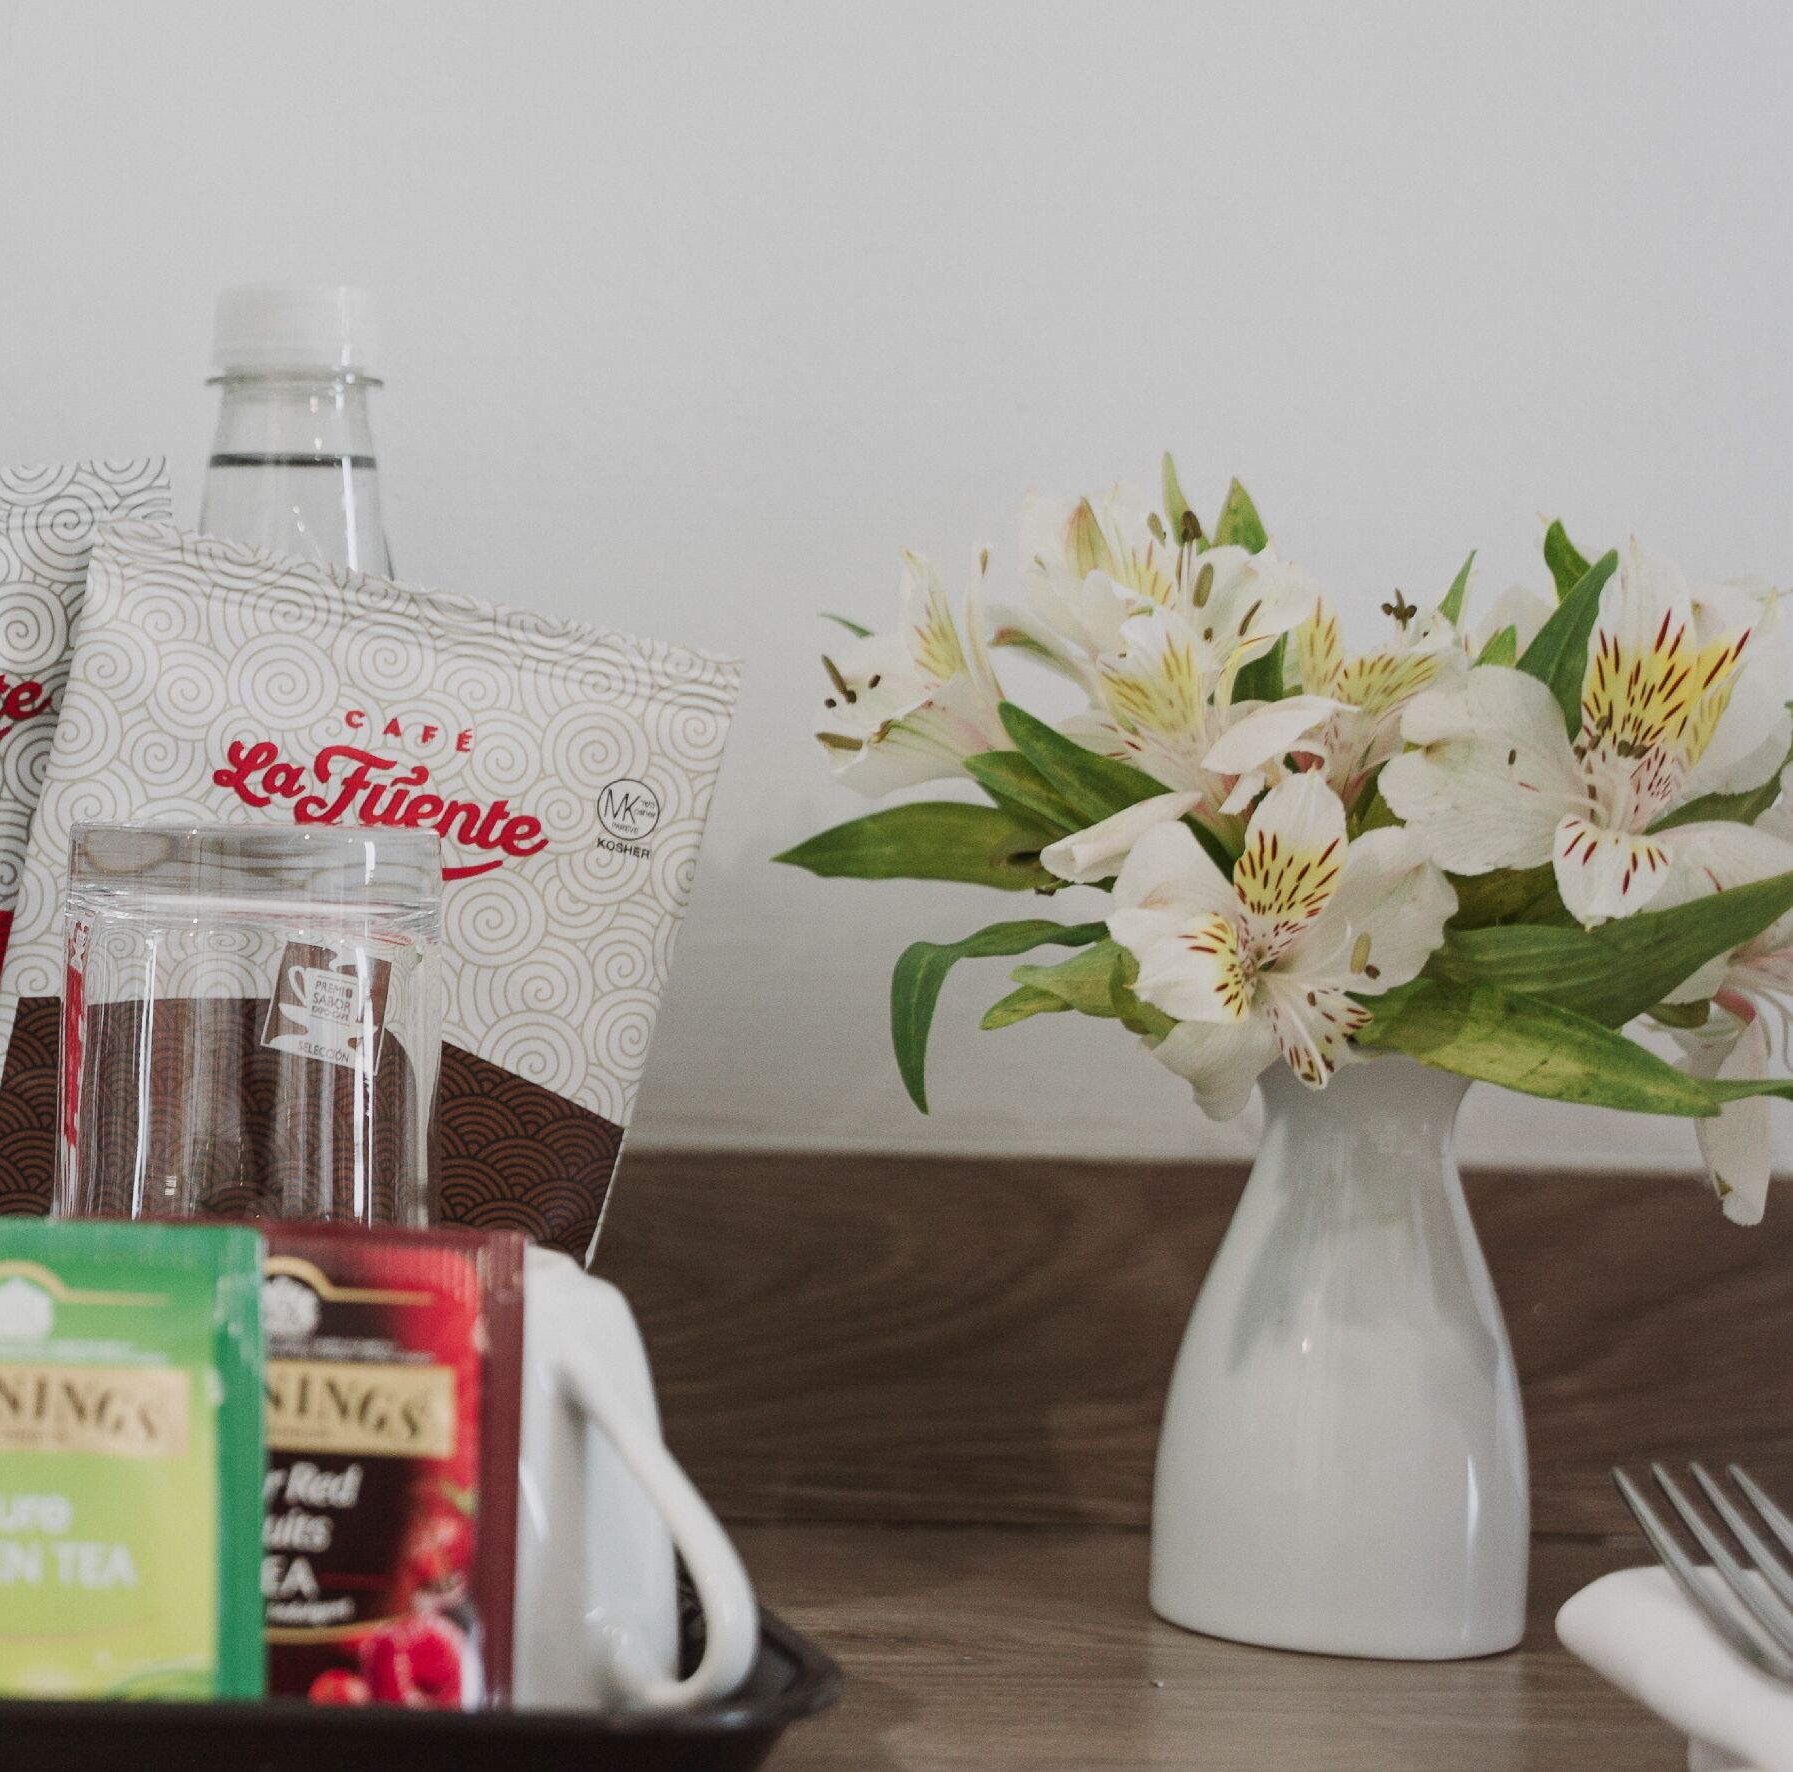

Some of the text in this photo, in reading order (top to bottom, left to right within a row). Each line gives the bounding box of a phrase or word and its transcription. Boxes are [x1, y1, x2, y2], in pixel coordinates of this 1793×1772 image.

[344, 709, 474, 753] CAFÉ
[212, 739, 306, 808] La
[596, 837, 650, 860] KOSHER
[312, 992, 351, 1013] SABOR
[315, 980, 354, 999] PREMIO
[298, 1040, 351, 1063] SELECCIÓN
[284, 1460, 365, 1509] Red
[52, 1541, 139, 1591] TEA
